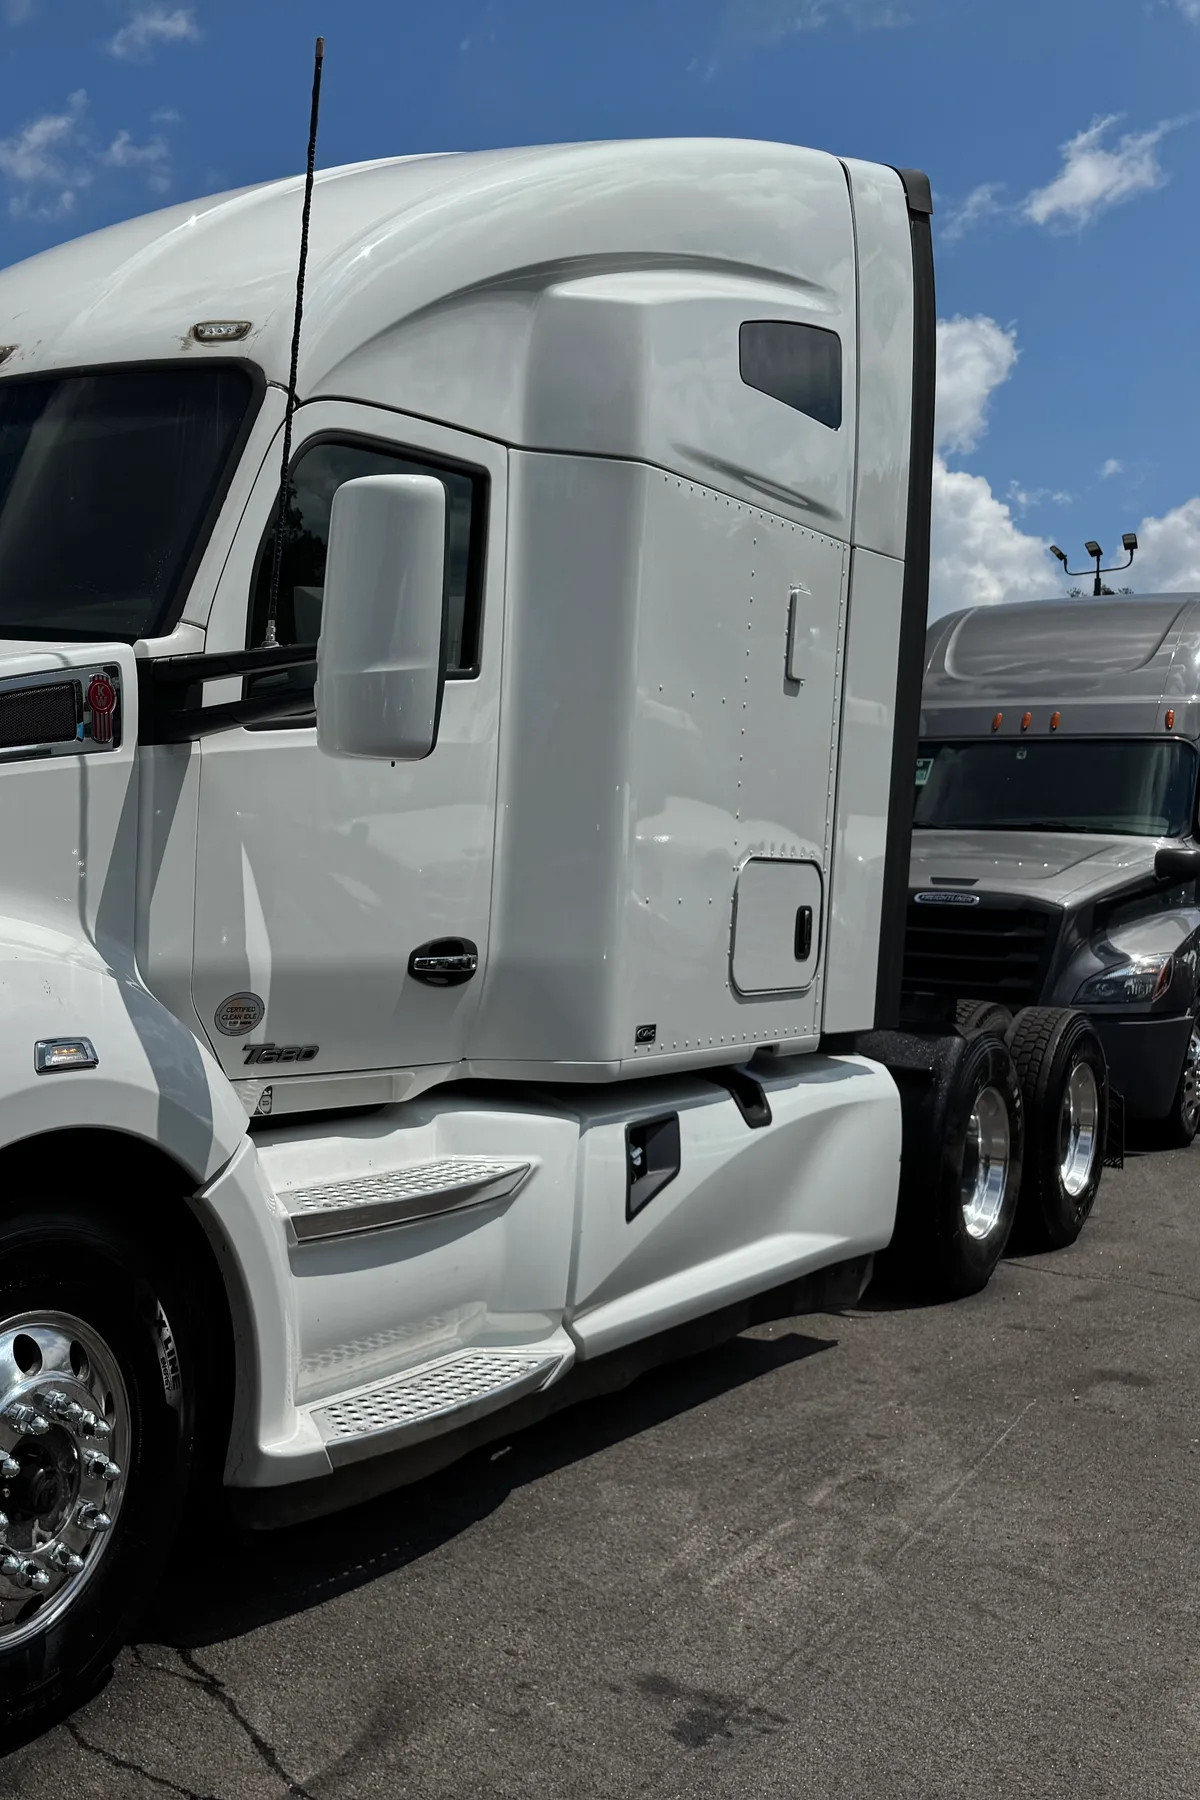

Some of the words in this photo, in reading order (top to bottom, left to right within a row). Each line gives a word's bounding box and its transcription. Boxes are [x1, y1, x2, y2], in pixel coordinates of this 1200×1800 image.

[242, 1043, 320, 1065] T680
[160, 1357, 172, 1391] ENERGY
[163, 1335, 181, 1391] LINE
